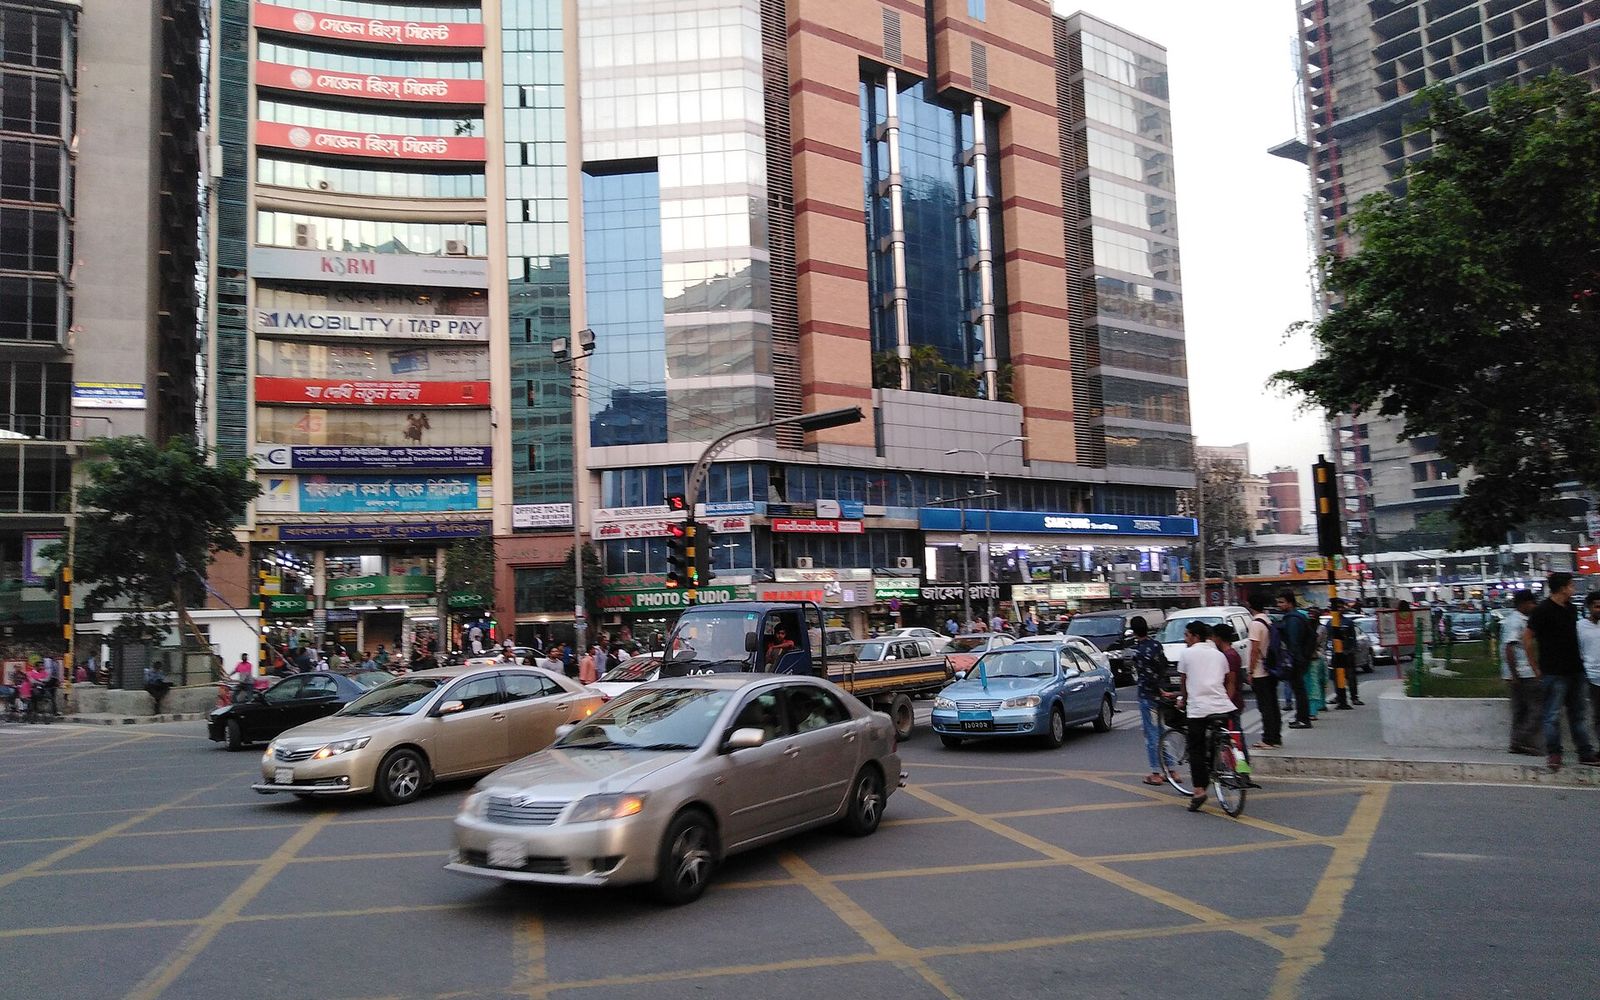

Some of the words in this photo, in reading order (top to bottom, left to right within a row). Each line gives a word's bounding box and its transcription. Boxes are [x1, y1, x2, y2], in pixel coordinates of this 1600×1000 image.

[320, 17, 364, 34] সেভেন
[404, 22, 449, 40] সিমেন্ট
[317, 74, 362, 91] সেভেন
[403, 79, 448, 96] সিমেন্ট
[315, 132, 361, 150] সেভেন
[403, 137, 447, 154] সিমেন্ট
[321, 257, 375, 276] KSRM
[284, 313, 394, 332] MOBILITY
[409, 319, 439, 333] TAP
[449, 321, 482, 335] PAY
[305, 386, 323, 398] যা
[354, 387, 388, 402] নতুন
[390, 388, 420, 400] লাগে
[515, 506, 541, 514] OFFICE
[1044, 517, 1090, 529] SAMSUNG
[636, 592, 680, 606] PHOTO
[682, 590, 730, 604] STUDIO
